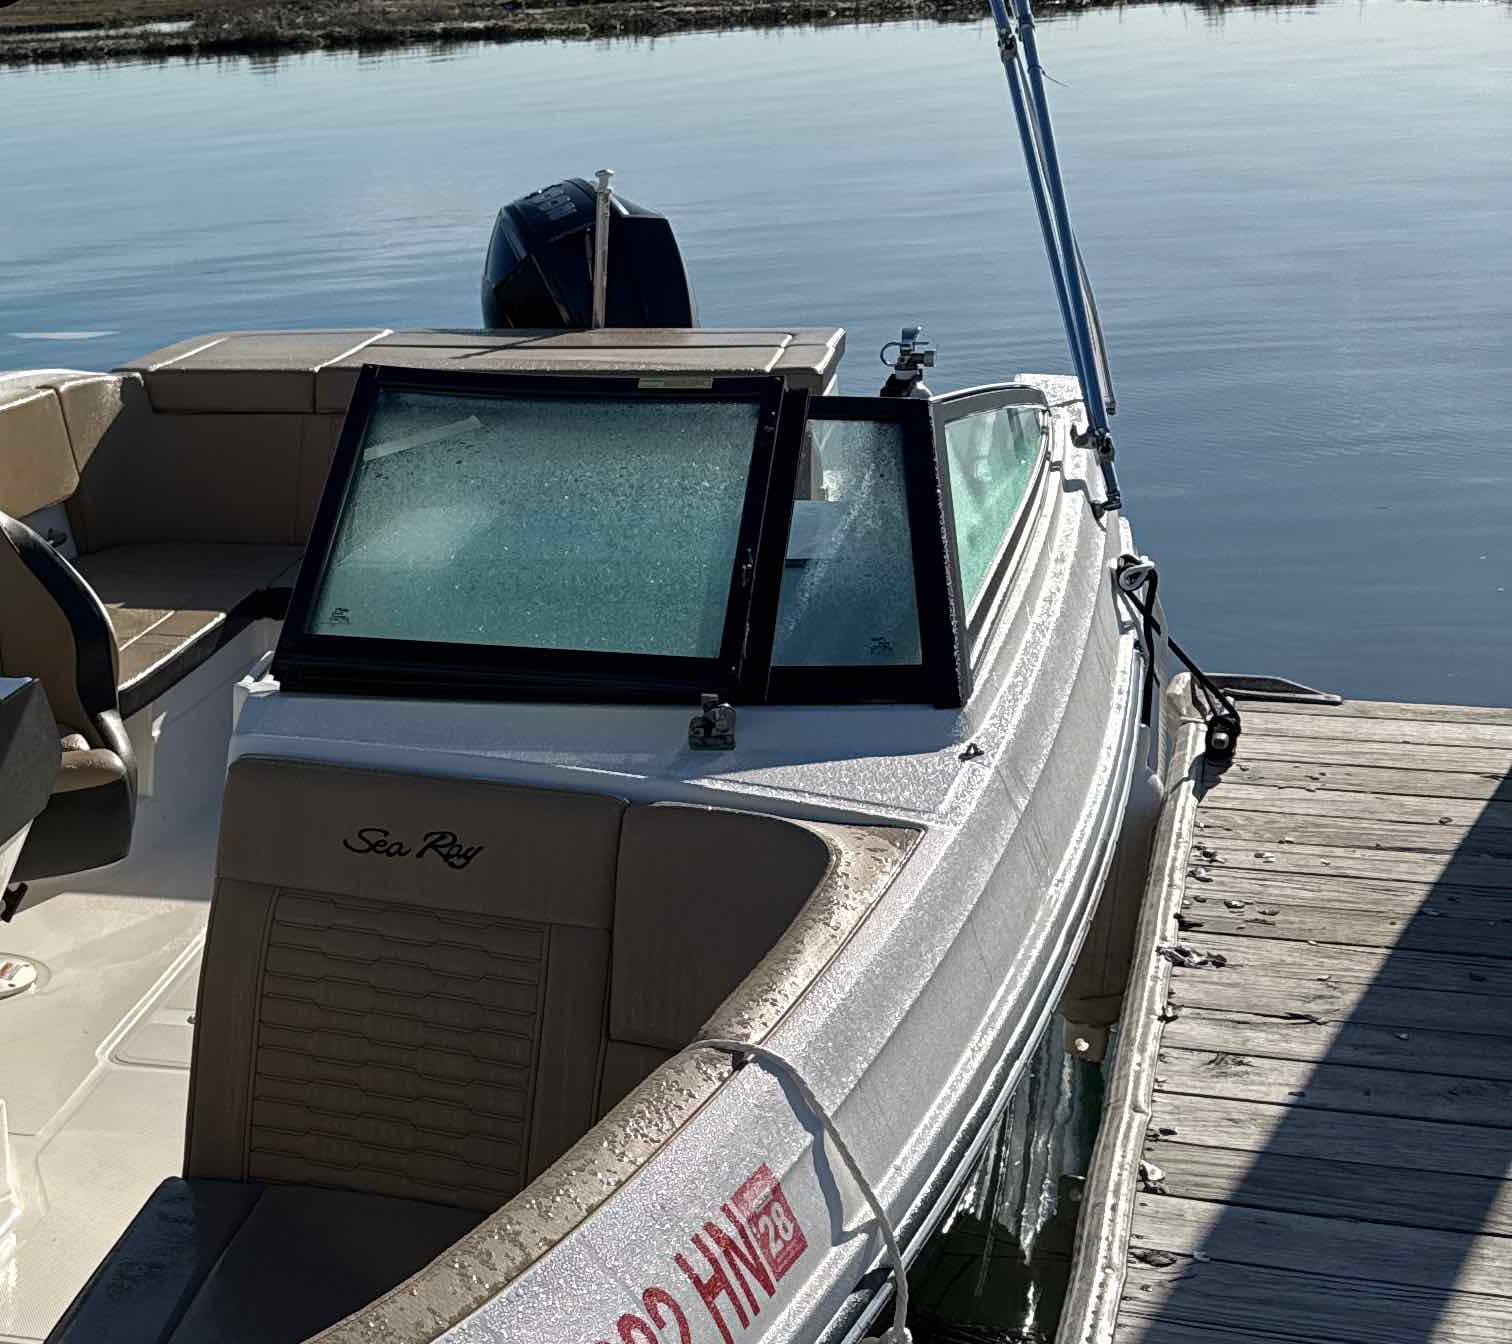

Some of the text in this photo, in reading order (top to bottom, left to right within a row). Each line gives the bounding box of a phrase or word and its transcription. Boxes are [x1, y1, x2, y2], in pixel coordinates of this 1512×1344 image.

[343, 827, 485, 869] Sea Ray
[758, 1200, 794, 1258] 28
